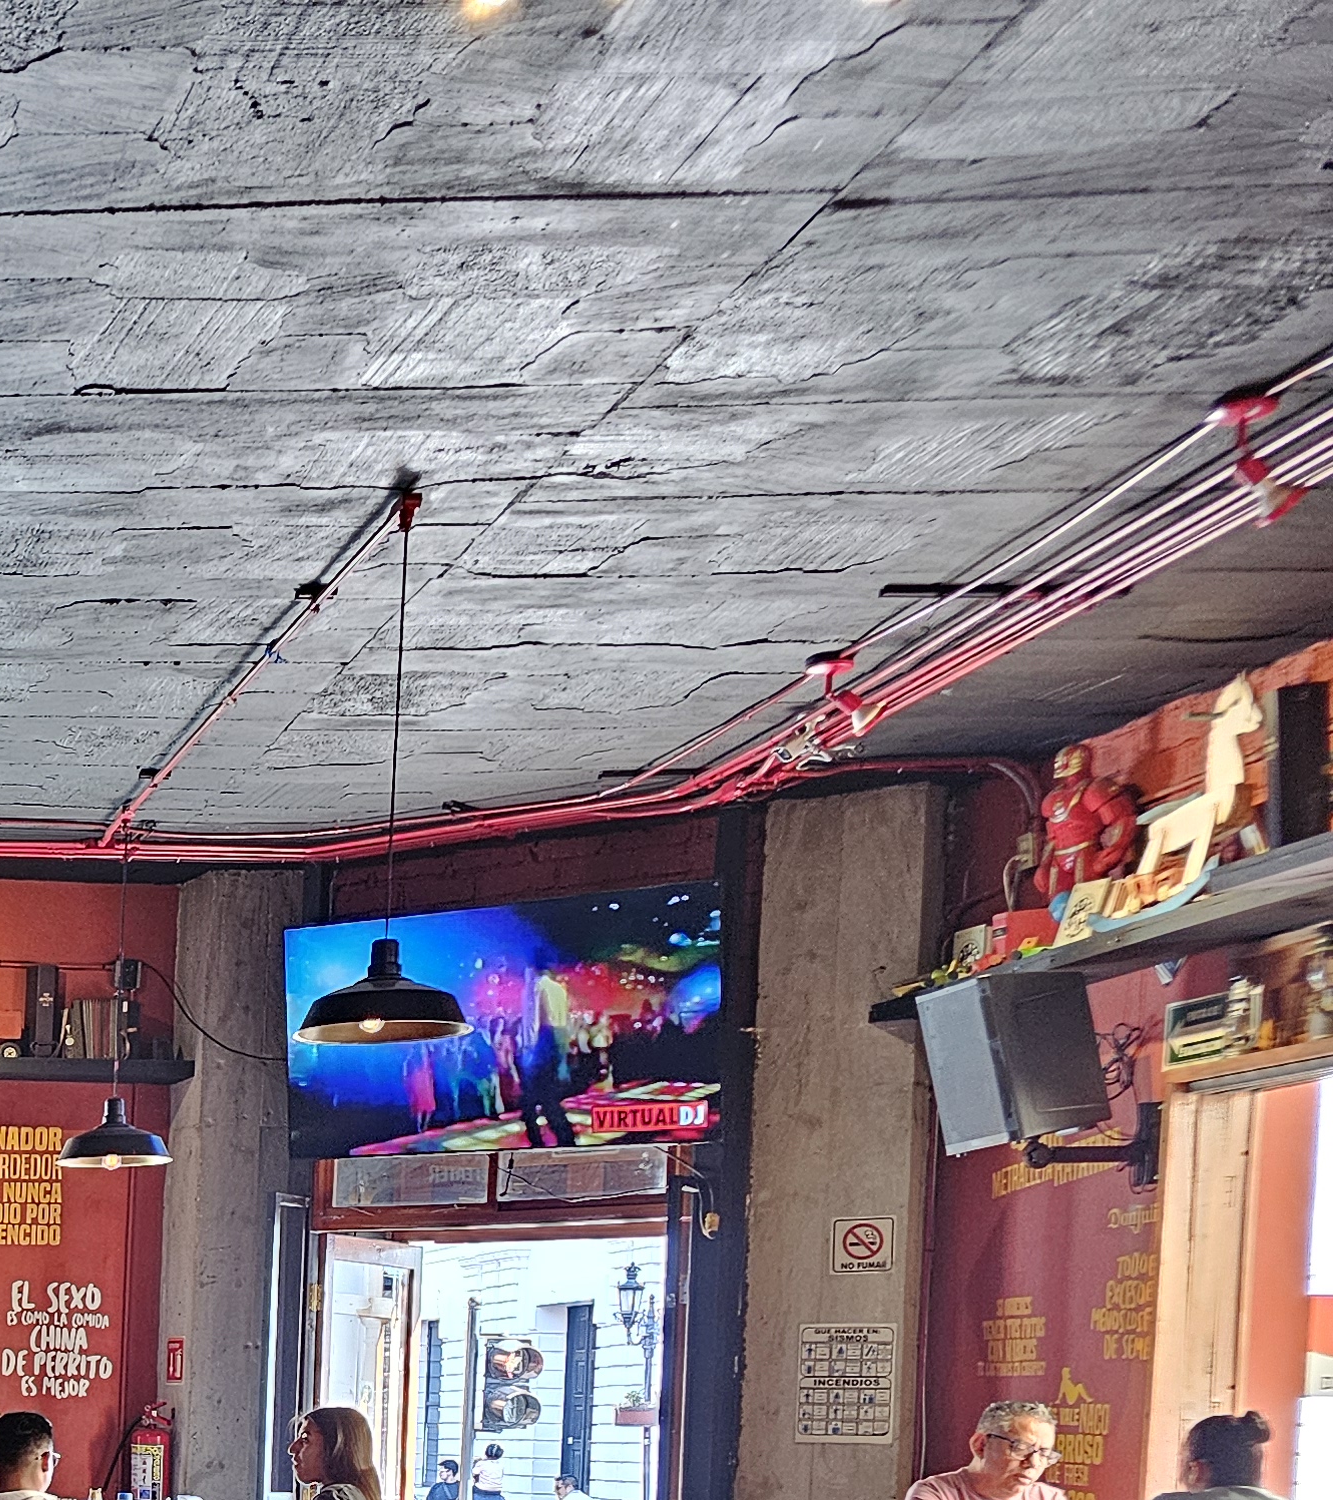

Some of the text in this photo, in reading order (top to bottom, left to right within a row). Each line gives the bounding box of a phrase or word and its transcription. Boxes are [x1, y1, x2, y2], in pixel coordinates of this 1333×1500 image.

[3, 1182, 62, 1203] NUNCA
[26, 1203, 62, 1224] POR
[857, 1261, 887, 1269] FUMAR
[11, 1280, 102, 1313] EL SEXO
[7, 1310, 109, 1329] ES COMO LA COMIDA
[30, 1325, 88, 1354] CHINA
[828, 1335, 869, 1343] SISMOS
[2, 1349, 113, 1379] DE PERRITO
[21, 1376, 90, 1399] ES MEJOR
[813, 1379, 881, 1387] INCENDIOS
